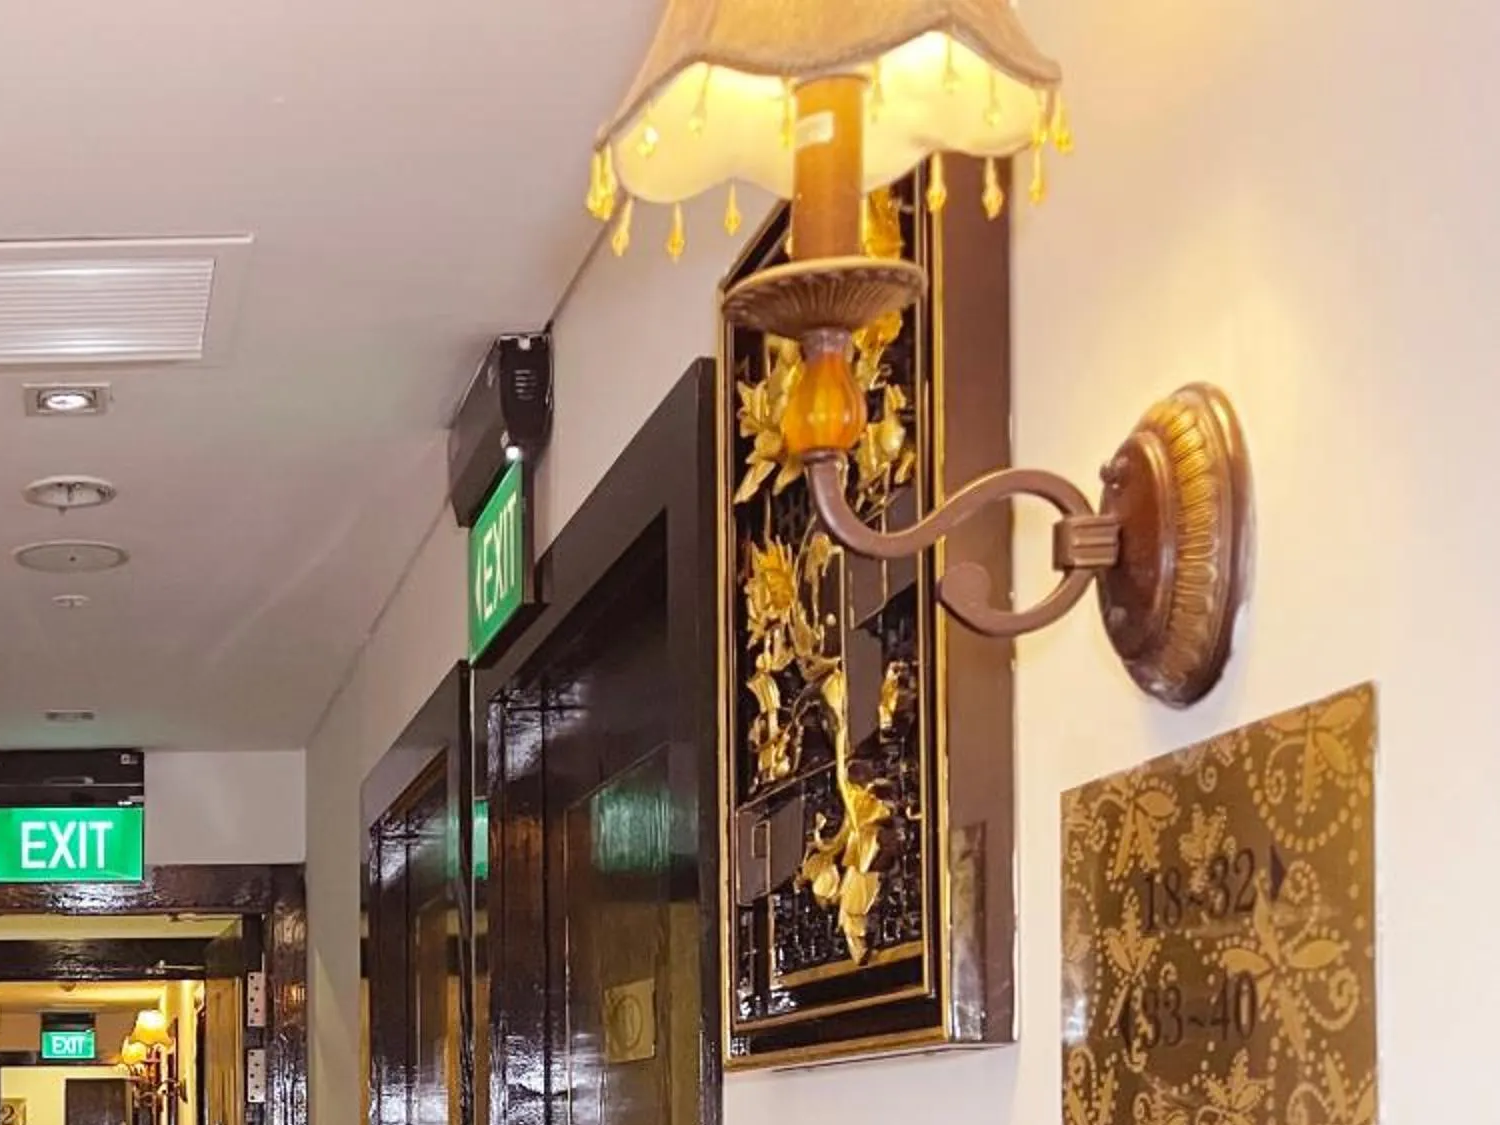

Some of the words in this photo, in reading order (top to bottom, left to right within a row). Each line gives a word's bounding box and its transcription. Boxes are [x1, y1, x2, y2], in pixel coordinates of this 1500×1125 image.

[483, 491, 517, 621] EXIT
[21, 821, 113, 869] EXIT
[52, 1036, 85, 1054] EXIT
